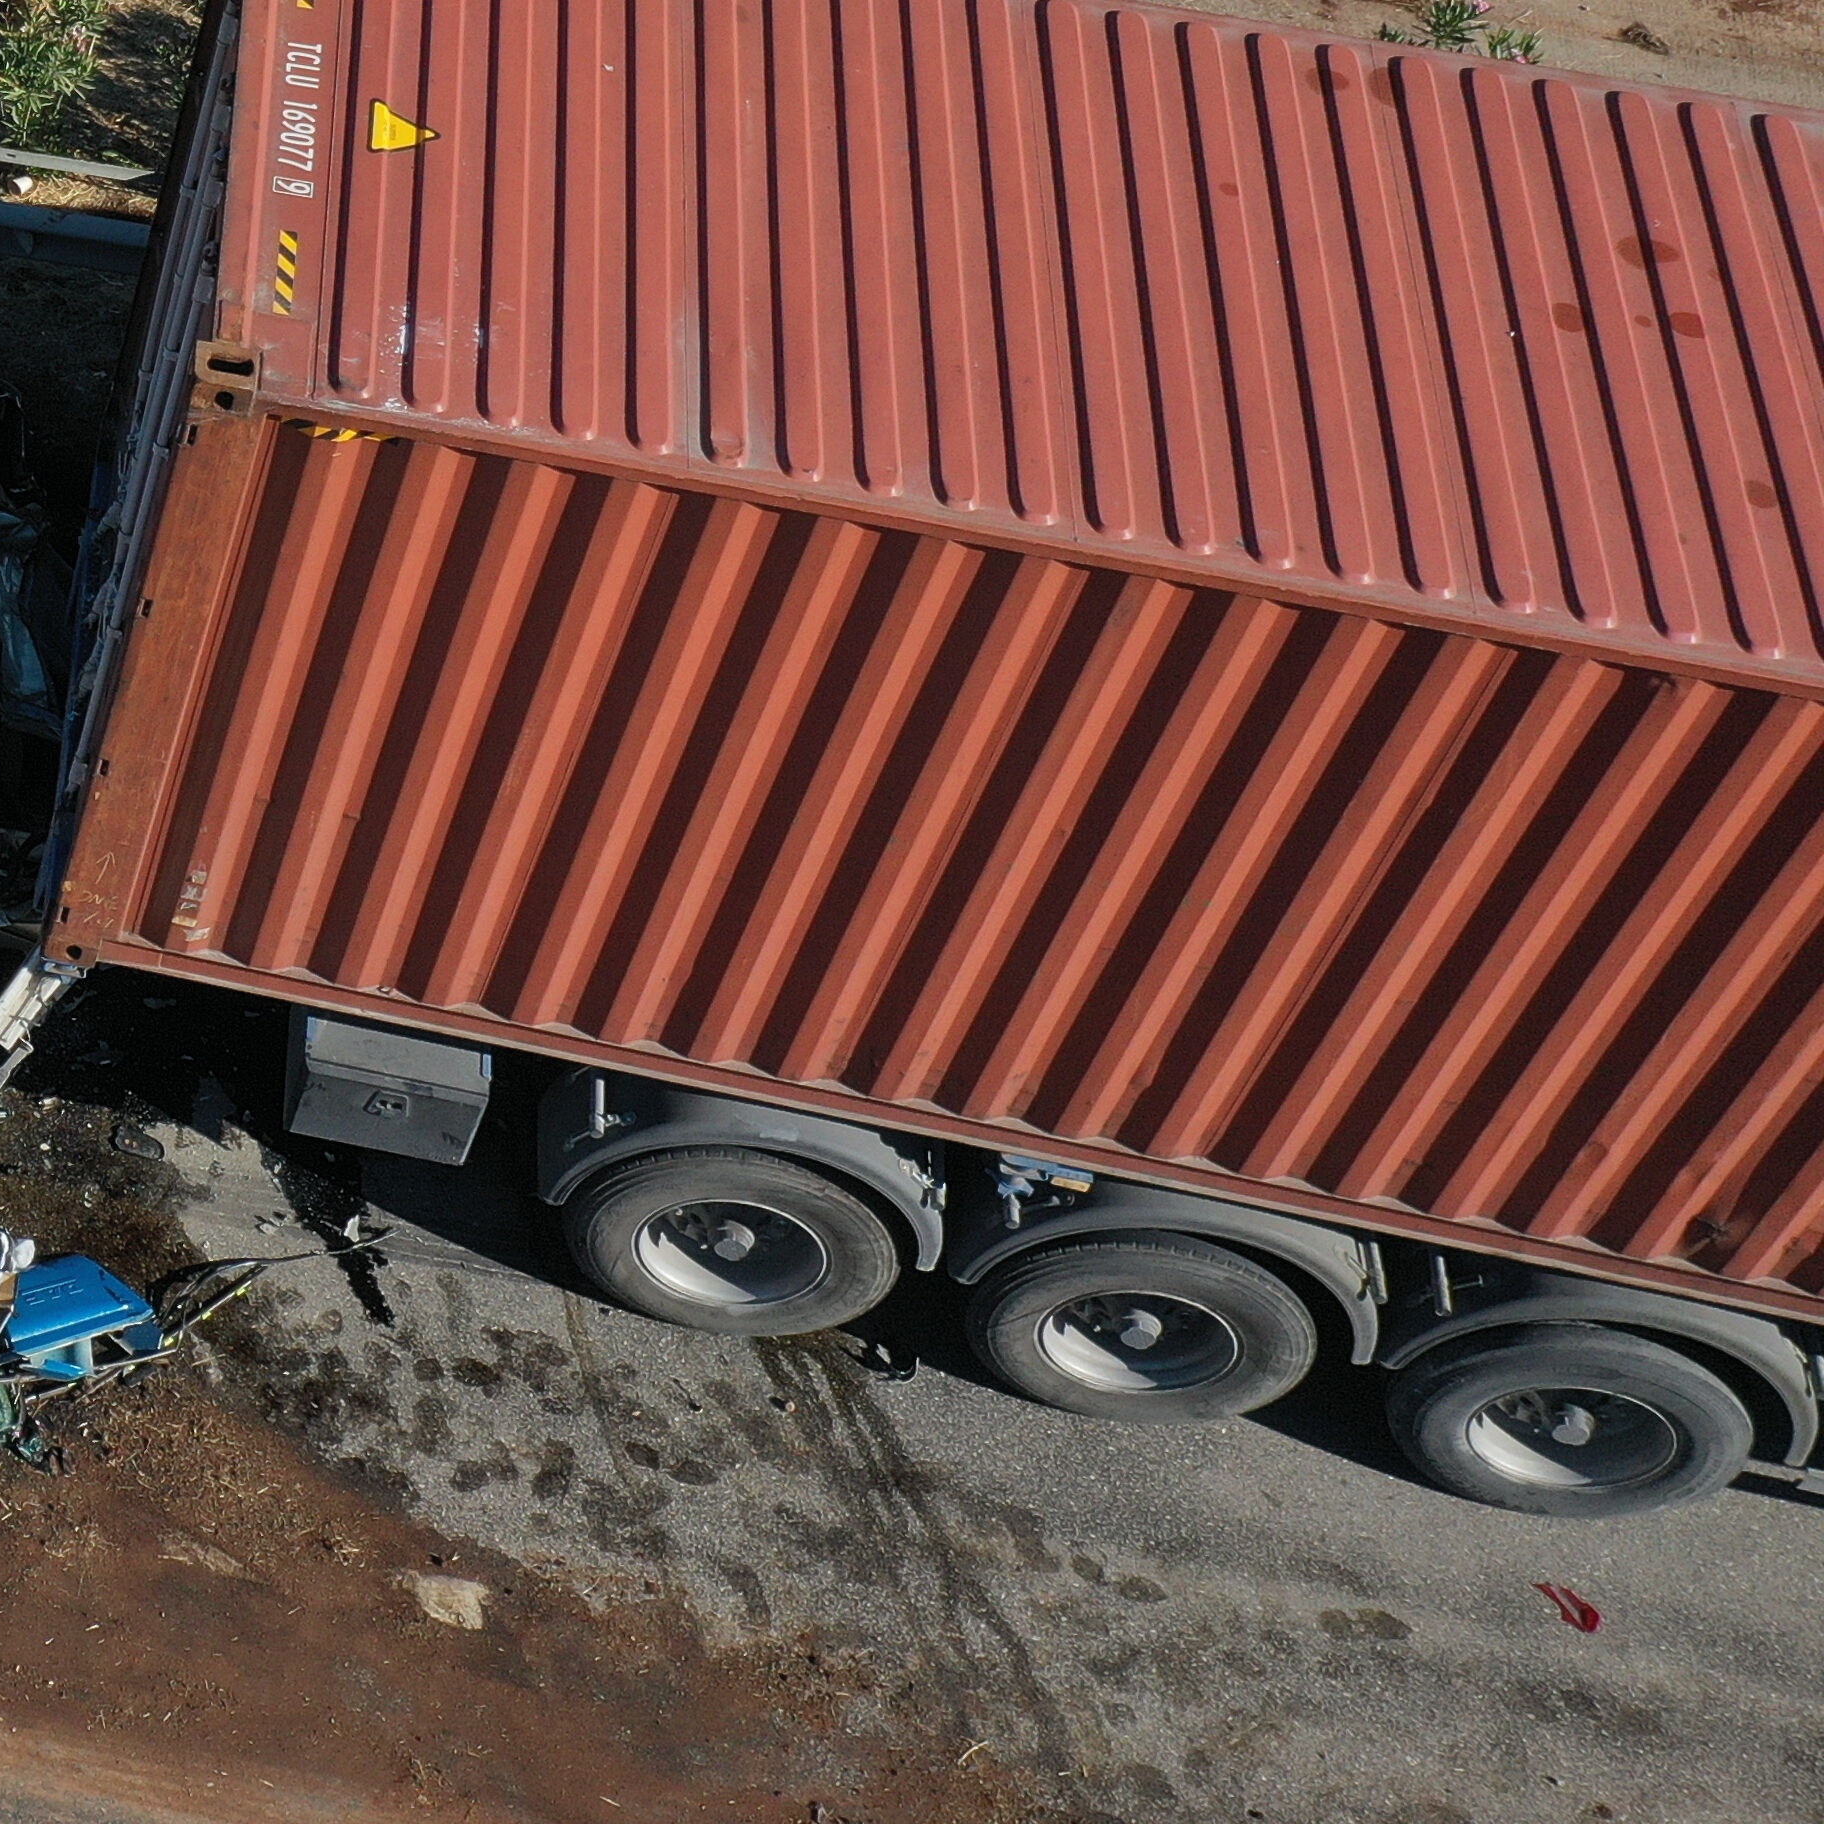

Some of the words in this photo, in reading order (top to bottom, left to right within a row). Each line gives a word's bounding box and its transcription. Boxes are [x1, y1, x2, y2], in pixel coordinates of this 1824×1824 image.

[285, 42, 322, 89] TCLU
[277, 100, 318, 172] 169077
[274, 178, 312, 196] 9
